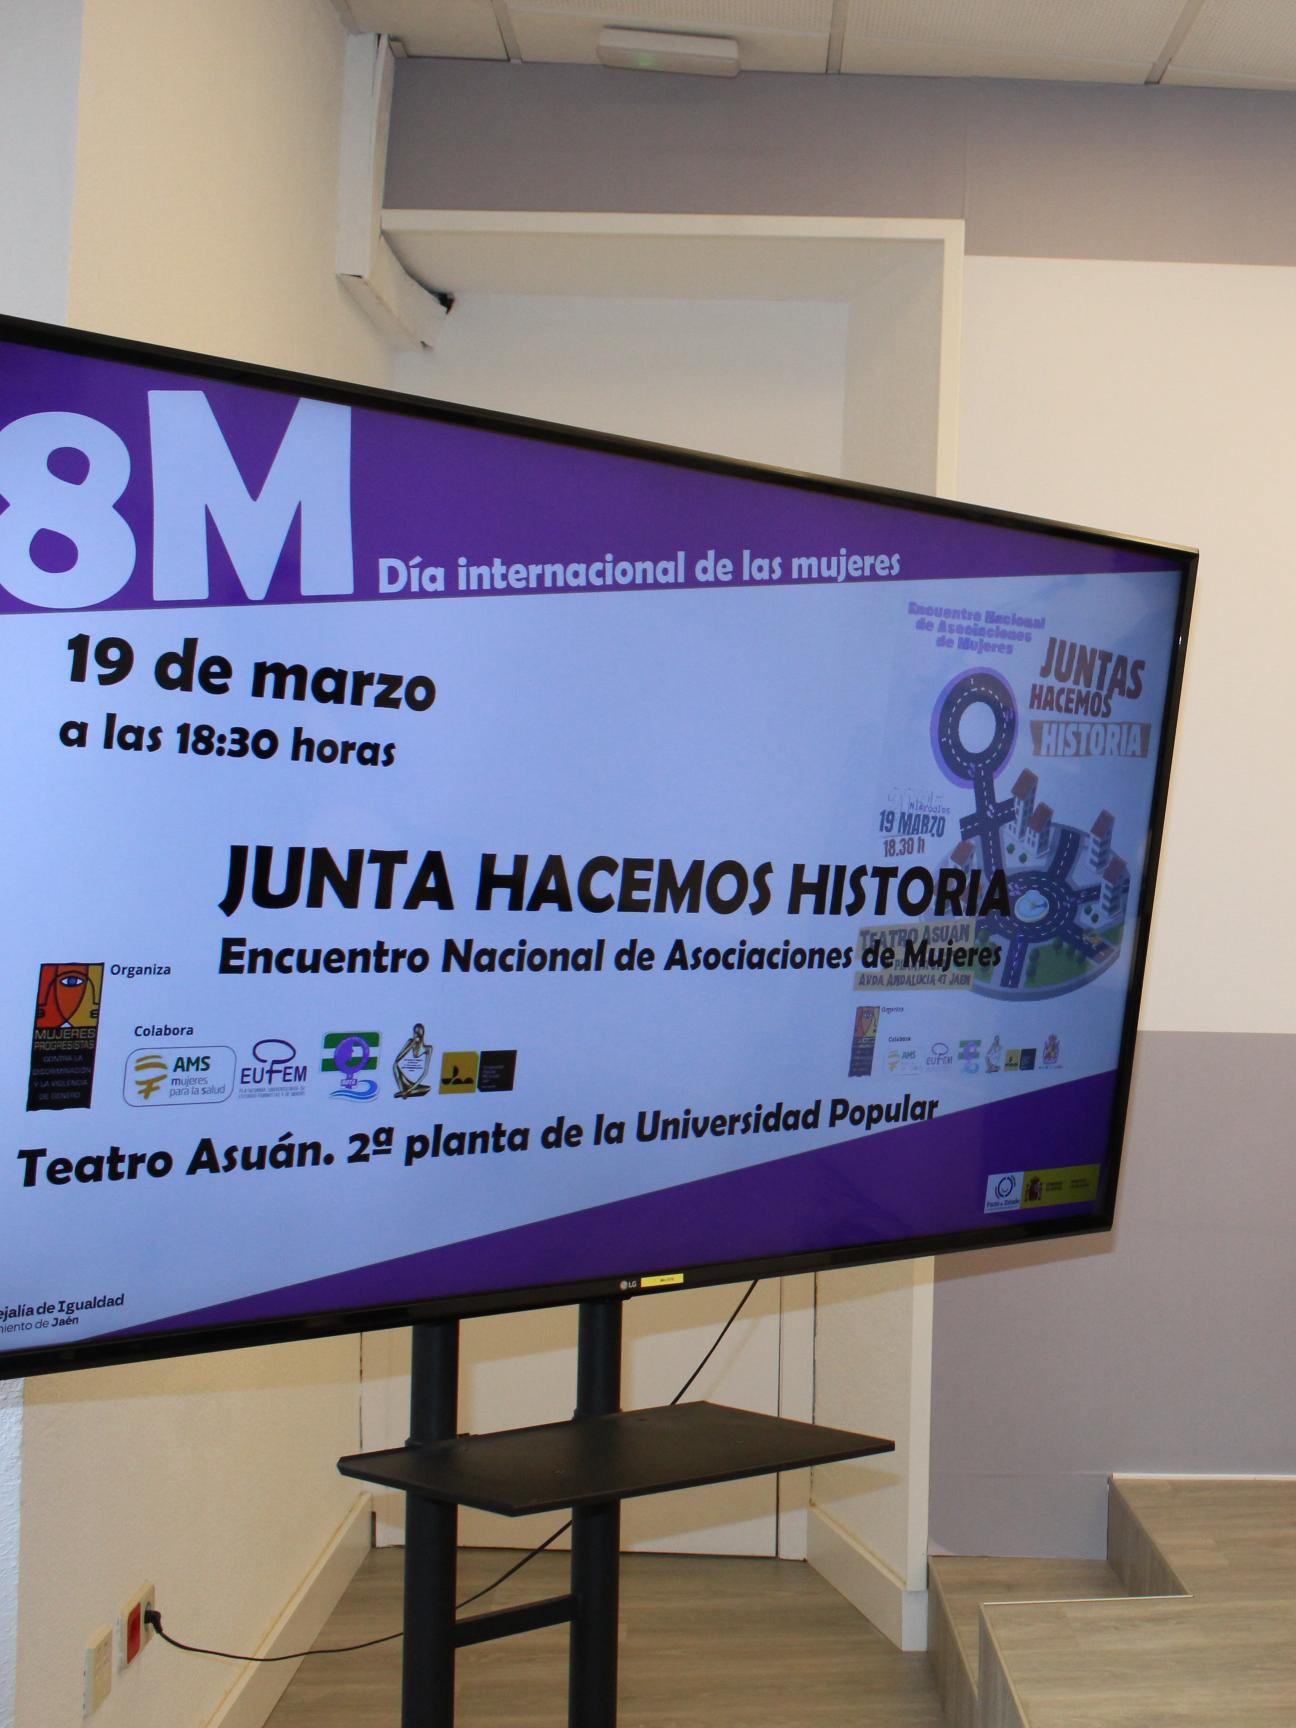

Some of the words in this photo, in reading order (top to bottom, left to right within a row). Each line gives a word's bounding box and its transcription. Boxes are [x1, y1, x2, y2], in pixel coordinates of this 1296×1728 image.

[0, 389, 354, 609] 8M
[377, 556, 445, 594] Día
[457, 550, 685, 590] internacional
[694, 550, 733, 582] de
[742, 549, 782, 580] las
[791, 547, 901, 583] mujeres
[907, 602, 982, 623] Encuentro
[985, 610, 1046, 630] Nacional
[915, 617, 934, 632] de
[936, 635, 954, 649] de
[957, 636, 1014, 655] Mujeres
[66, 632, 135, 686] 19
[154, 637, 233, 695] de
[250, 658, 437, 711] marzo
[1040, 637, 1146, 700] JUNTAS
[1029, 683, 1112, 718] HACEMOS
[58, 720, 89, 748] a
[103, 712, 162, 753] las
[176, 721, 280, 760] 18:30
[291, 726, 397, 768] horas
[1041, 721, 1142, 757] HISTORIA
[880, 809, 895, 833] 19
[897, 811, 946, 838] MARZO
[883, 837, 914, 857] 18.30
[917, 836, 925, 854] h
[217, 844, 455, 918] JUNTA
[475, 853, 774, 917] HACEMOS
[787, 863, 1011, 917] HISTORIA
[218, 937, 430, 974] Encuentro
[441, 938, 605, 973] Nacional
[614, 939, 655, 971] de
[664, 939, 853, 971] Asociaciones
[860, 939, 895, 969] de
[902, 940, 1002, 974] Mujeres
[110, 964, 171, 978] Organiza
[34, 1028, 96, 1040] MUJERES
[134, 1024, 194, 1037] Colabora
[33, 1040, 95, 1051] PROGRESISTAS
[173, 1056, 211, 1073] AMS
[240, 1061, 308, 1085] EUFEM
[169, 1088, 190, 1098] para
[191, 1086, 200, 1095] la
[201, 1085, 226, 1095] salud
[171, 1076, 209, 1087] mujeres
[17, 1146, 173, 1188] Teatro
[186, 1131, 335, 1176] Asuán.
[347, 1126, 394, 1164] 2ª
[404, 1121, 530, 1166] planta
[541, 1116, 583, 1150] de
[593, 1113, 626, 1146] la
[636, 1099, 822, 1143] Universidad
[829, 1094, 939, 1131] Popular
[628, 1280, 637, 1288] LG
[36, 1302, 55, 1315] de
[58, 1293, 125, 1315] Igualdad
[35, 1319, 49, 1329] de
[51, 1315, 79, 1328] Jaén
